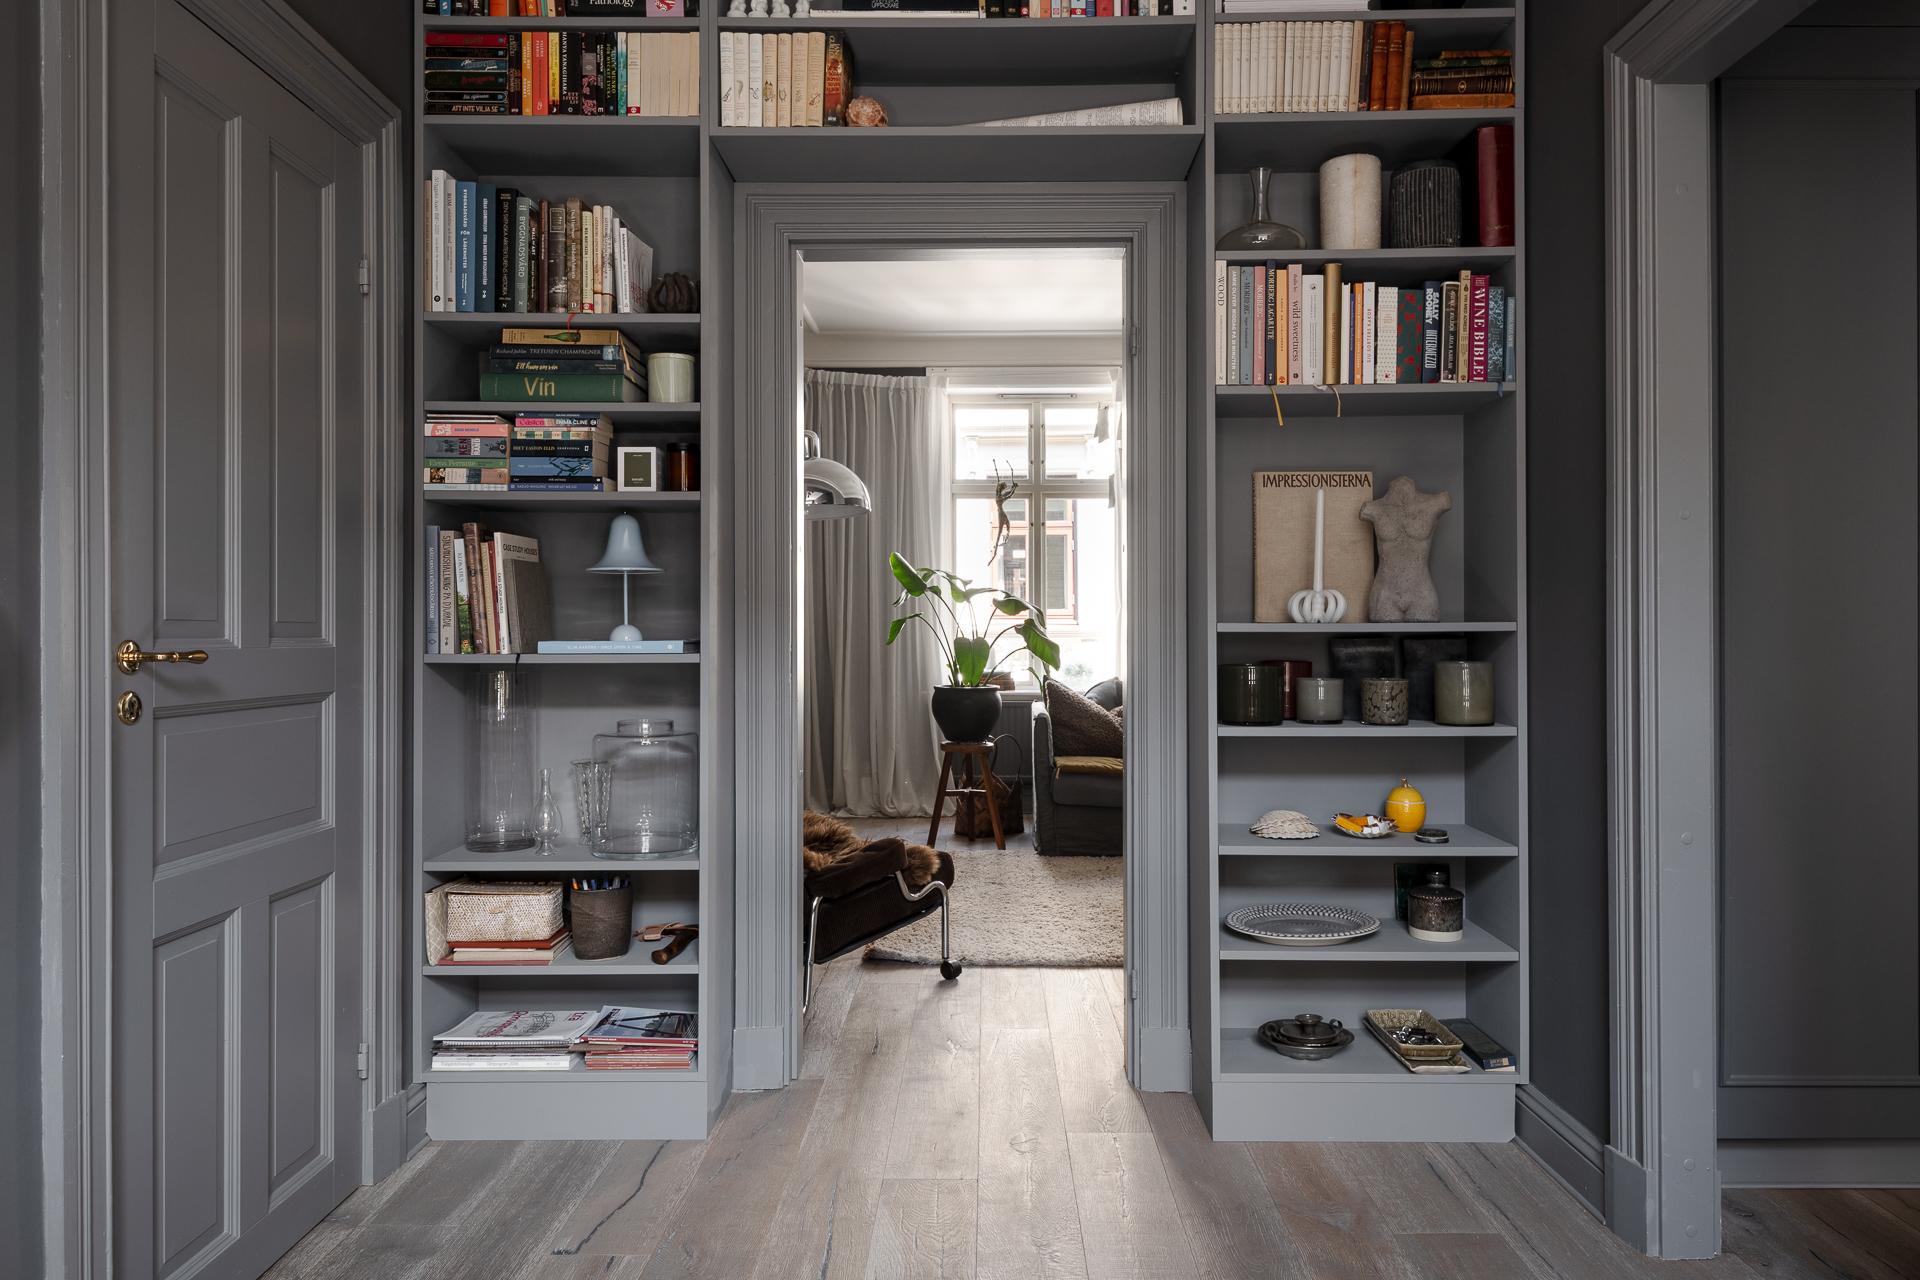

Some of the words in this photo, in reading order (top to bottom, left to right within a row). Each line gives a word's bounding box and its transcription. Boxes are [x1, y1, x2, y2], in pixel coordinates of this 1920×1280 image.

[518, 215, 527, 278] BYGGNADSVÅRD
[1217, 276, 1225, 307] WOOD
[1267, 269, 1275, 303] MORBERG
[1292, 300, 1301, 319] wild
[1425, 288, 1433, 325] ROONEY
[1432, 291, 1440, 320] SALLY
[1474, 288, 1486, 328] WINE
[1267, 326, 1275, 340] UTE
[1292, 321, 1300, 362] sweetness
[1425, 329, 1439, 369] INTERMEZZO
[1473, 331, 1485, 375] BIBLE
[524, 377, 556, 396] Vin
[1262, 473, 1372, 488] IMPRESSIONISTERNA
